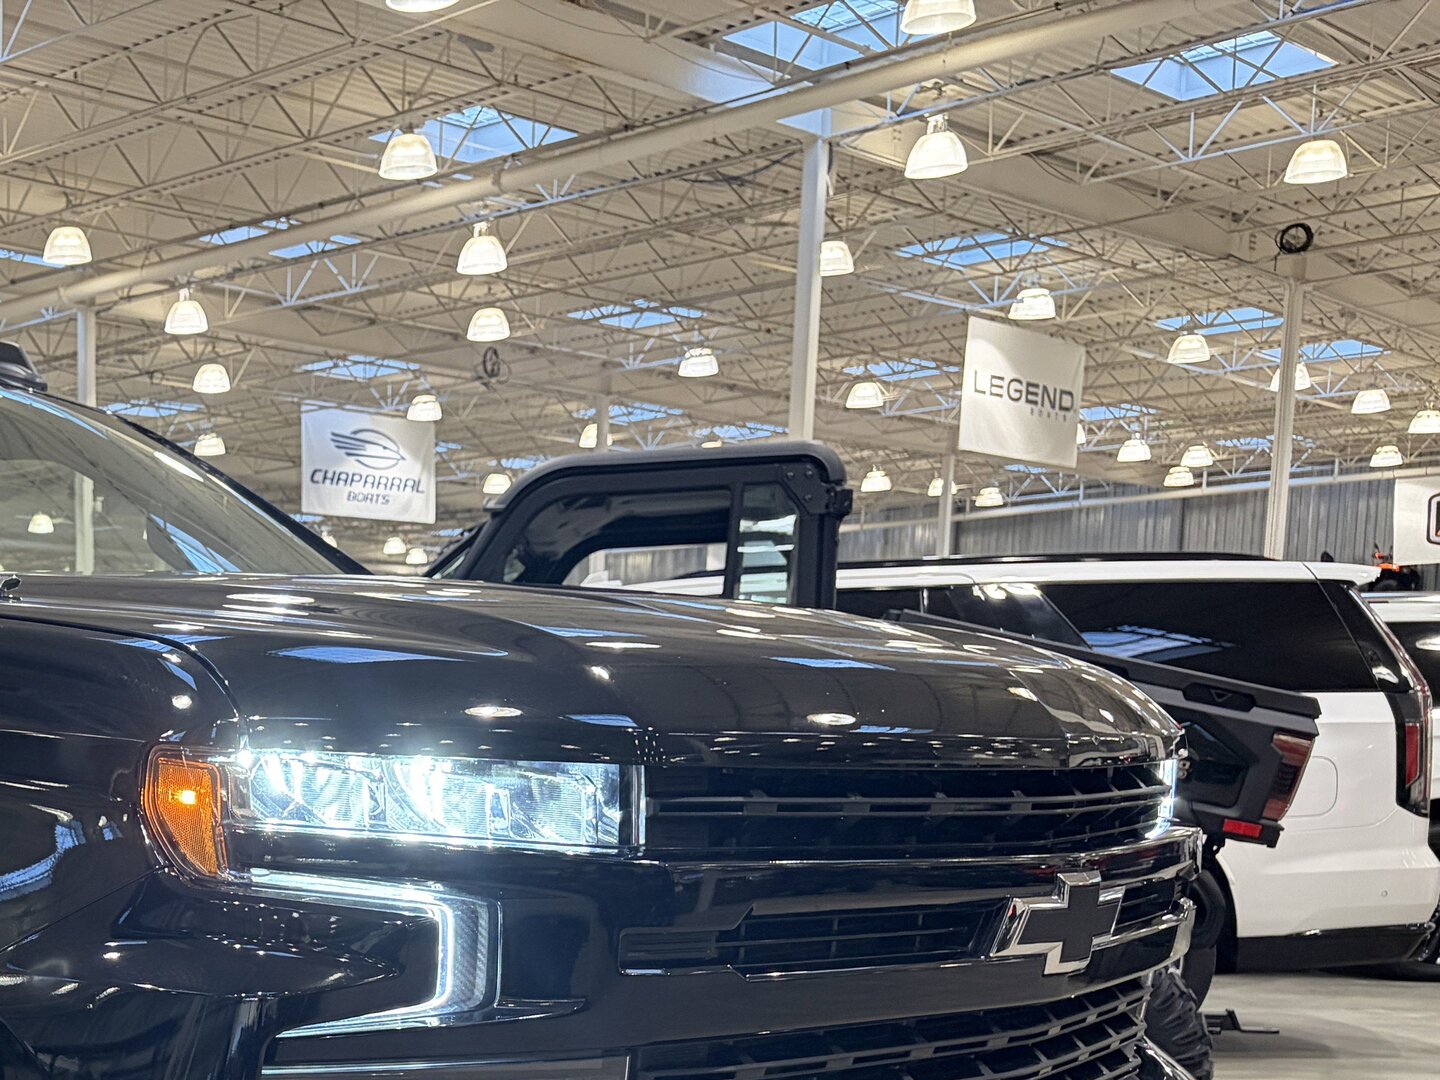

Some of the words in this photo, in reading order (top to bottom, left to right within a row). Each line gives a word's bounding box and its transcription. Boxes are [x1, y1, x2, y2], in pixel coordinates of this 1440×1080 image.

[974, 370, 1074, 411] LEGEND
[310, 468, 425, 494] CHAPARRAL
[346, 491, 391, 505] BOATS
